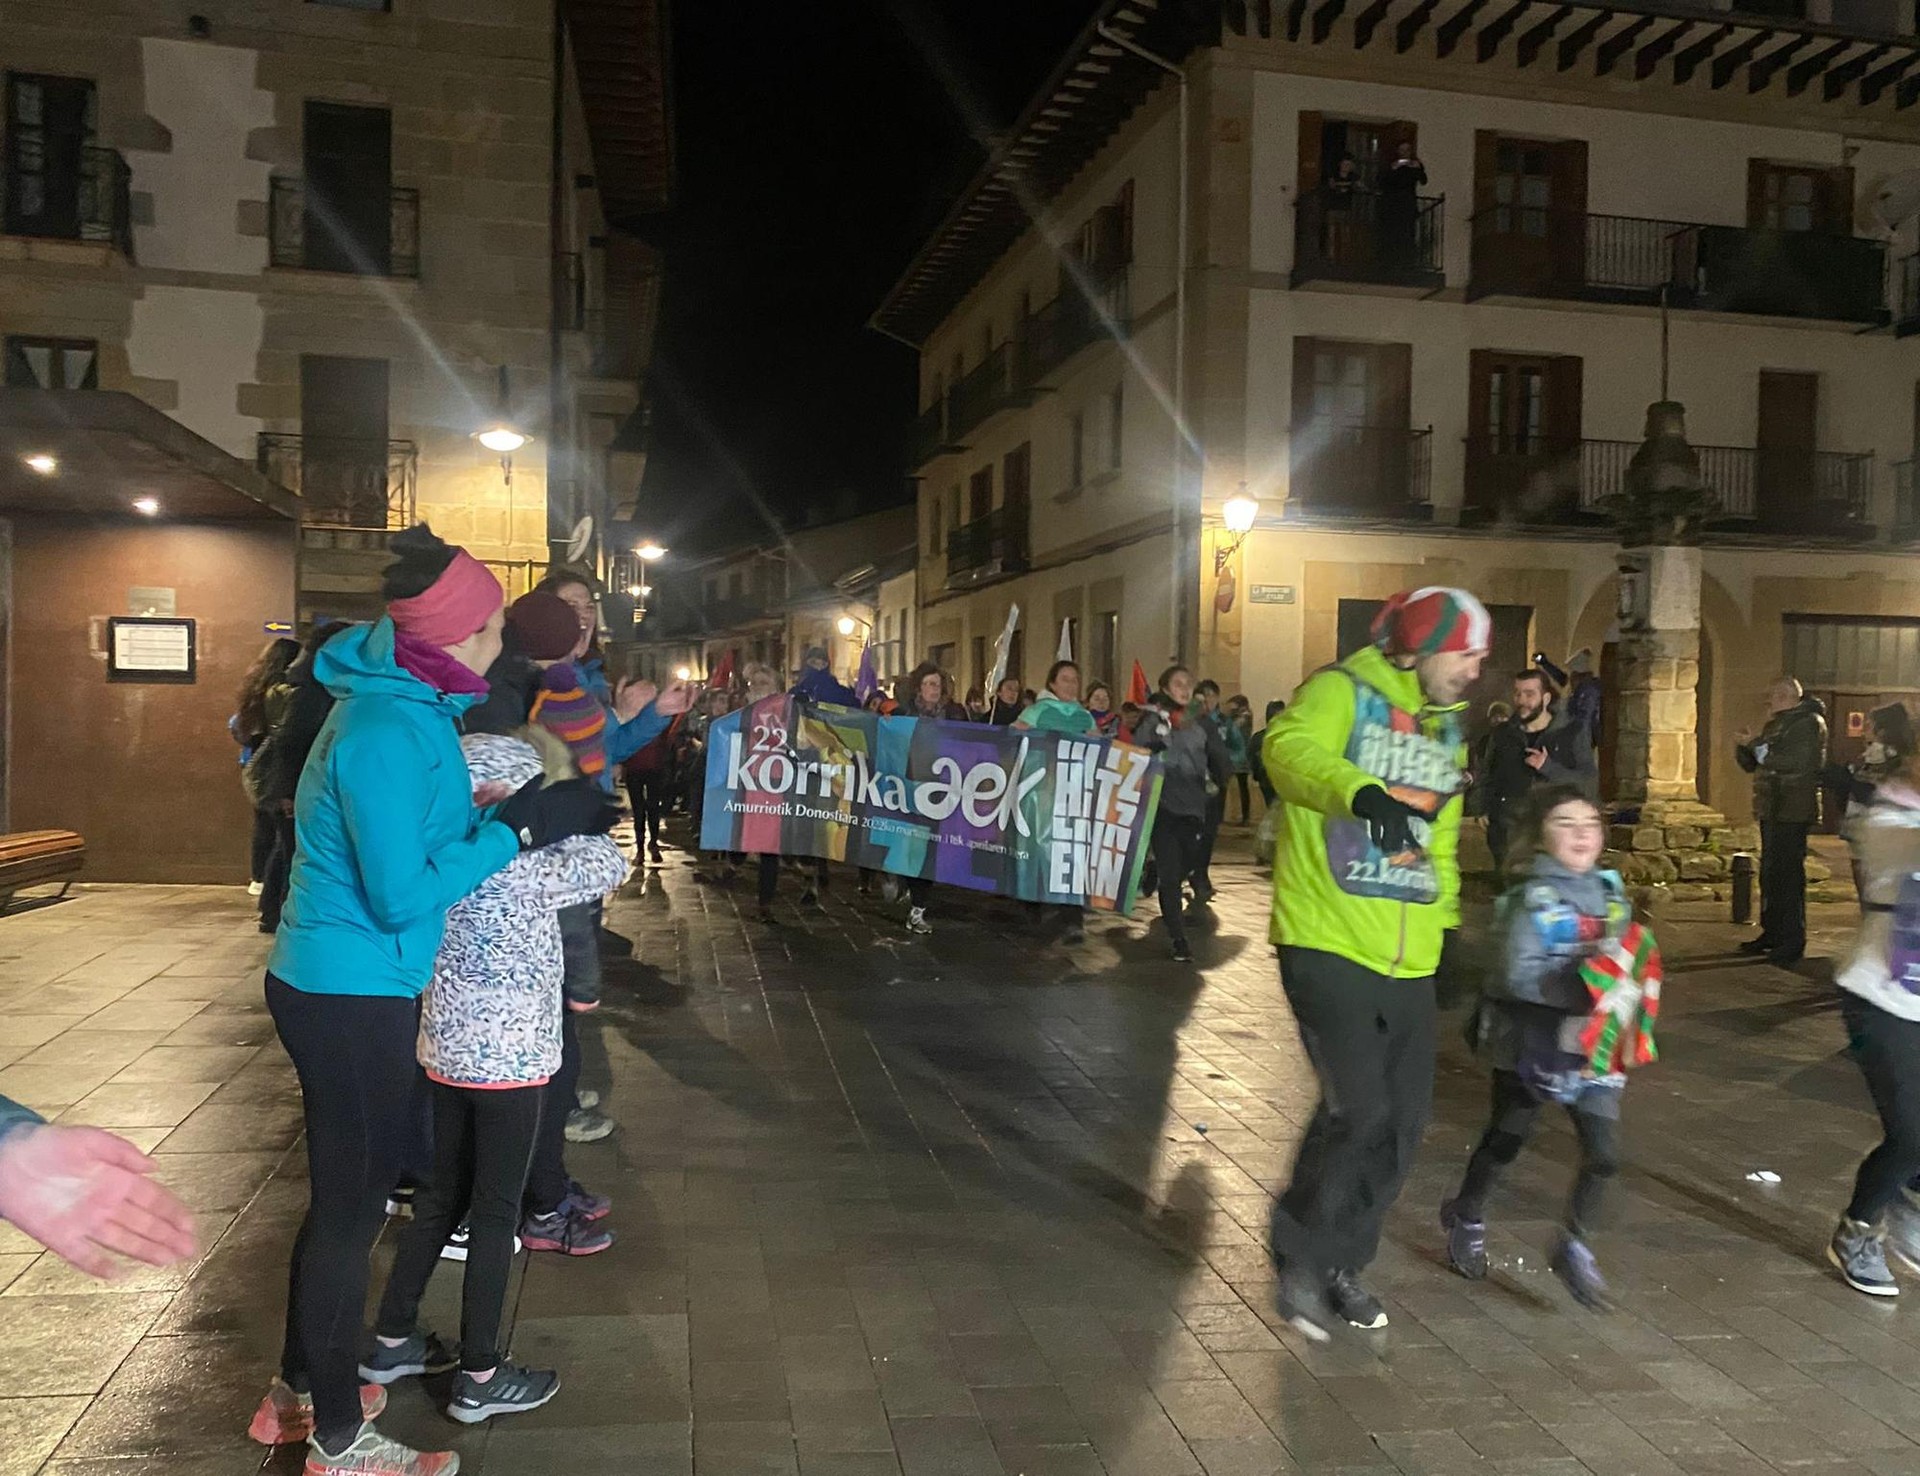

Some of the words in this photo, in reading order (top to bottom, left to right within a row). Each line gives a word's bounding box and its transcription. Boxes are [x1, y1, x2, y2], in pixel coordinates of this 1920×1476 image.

[723, 799, 793, 817] Amurriotik
[795, 804, 859, 826] Donostiara
[726, 731, 910, 814] korrika
[914, 736, 1047, 838] aek
